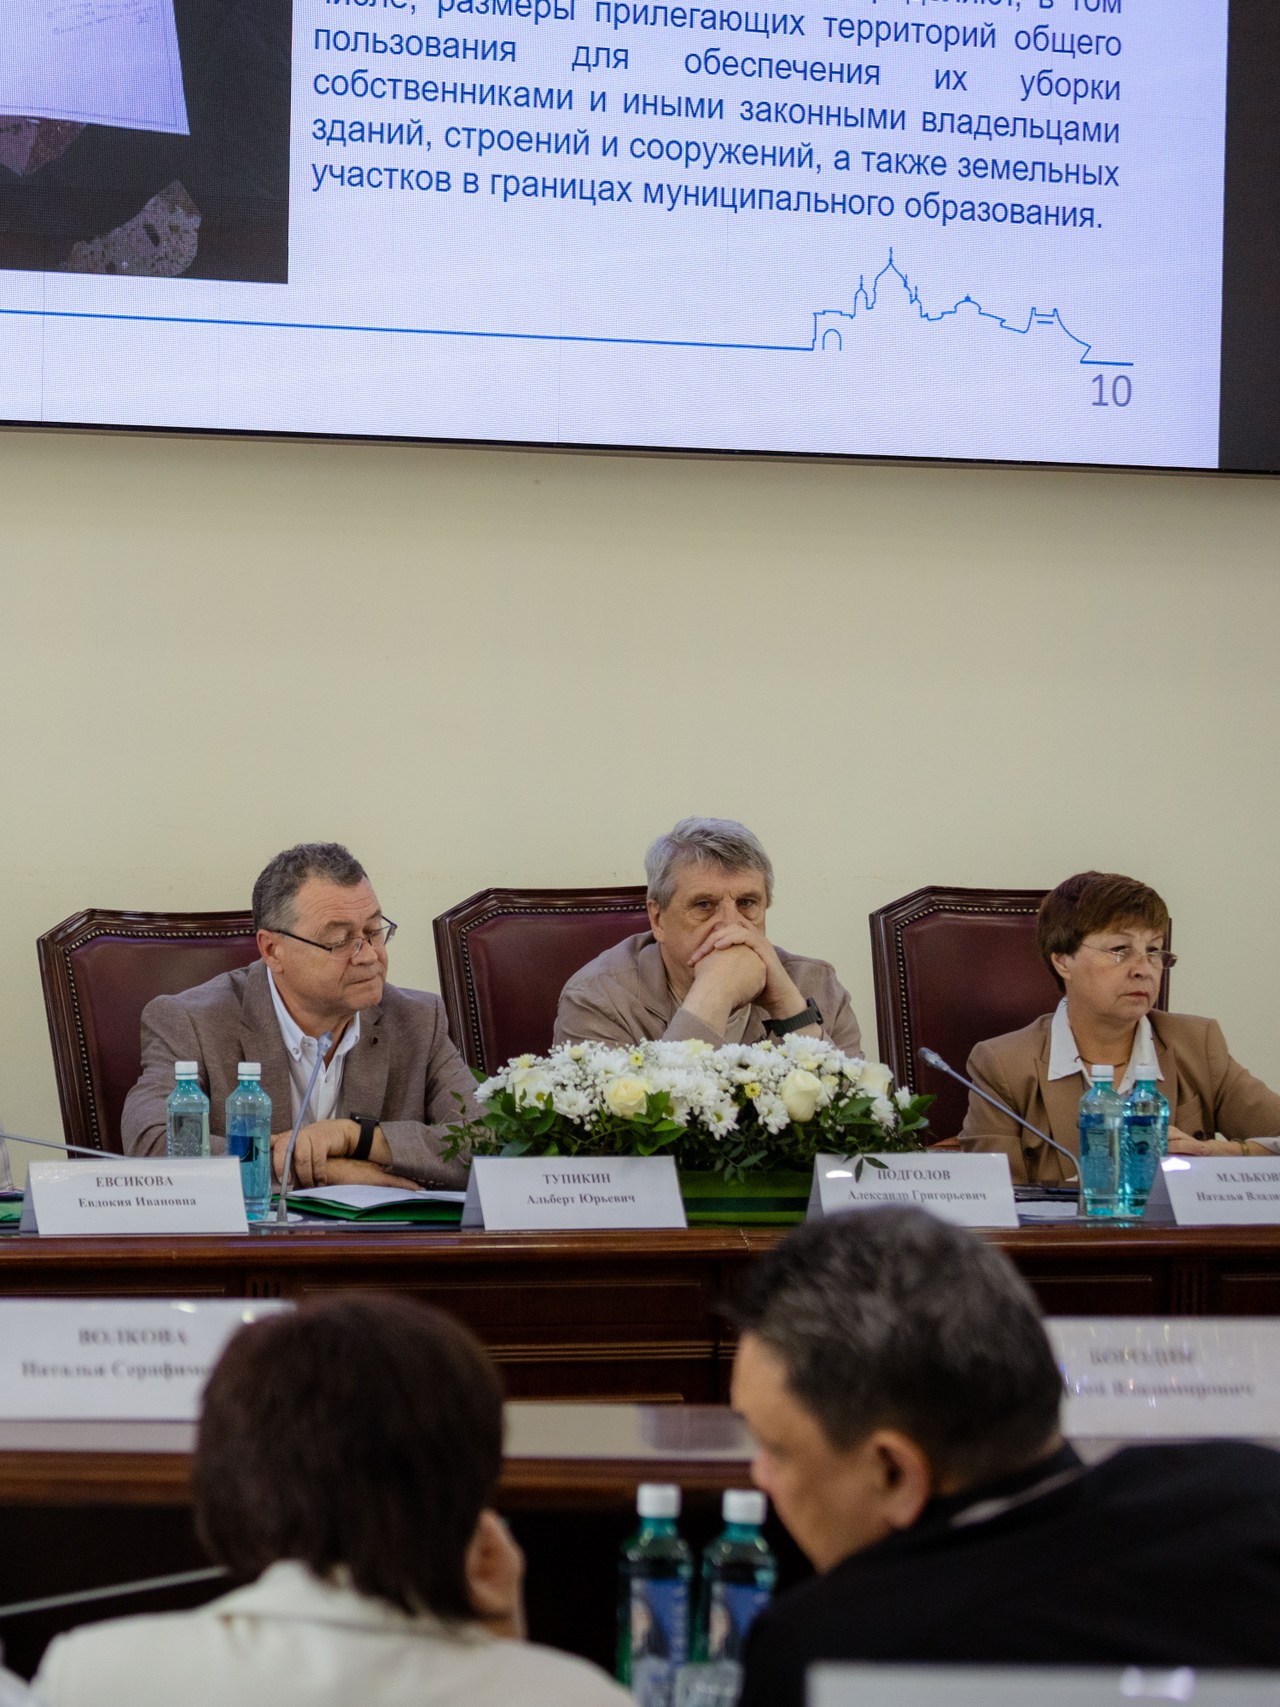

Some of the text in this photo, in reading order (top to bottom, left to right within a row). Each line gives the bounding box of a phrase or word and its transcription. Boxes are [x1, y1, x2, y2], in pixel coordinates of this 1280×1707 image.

[437, 0, 576, 25] размеры
[595, 1, 806, 40] прилегающих
[822, 16, 997, 52] территорий
[1014, 23, 1122, 59] общего
[314, 28, 1121, 105] пользования для обеспечения их уборки
[313, 68, 1120, 146] собственниками и иными законными владельцами
[311, 117, 1120, 188] зданий, строений и сооружений, а также земельных
[311, 163, 1103, 229] участков в границах муниципального образования.
[1091, 374, 1132, 407] 10
[95, 1175, 174, 1188] ЕВСИКОВА
[542, 1173, 611, 1185] ТУПИКИН
[877, 1169, 951, 1181] ПОДГОЛОВ
[1216, 1171, 1280, 1183] МАЛЬКОВ
[78, 1196, 197, 1208] Евдокия Ивановна
[527, 1193, 636, 1207] Альберт Юрьевич
[847, 1189, 987, 1202] Александр Григорьевич
